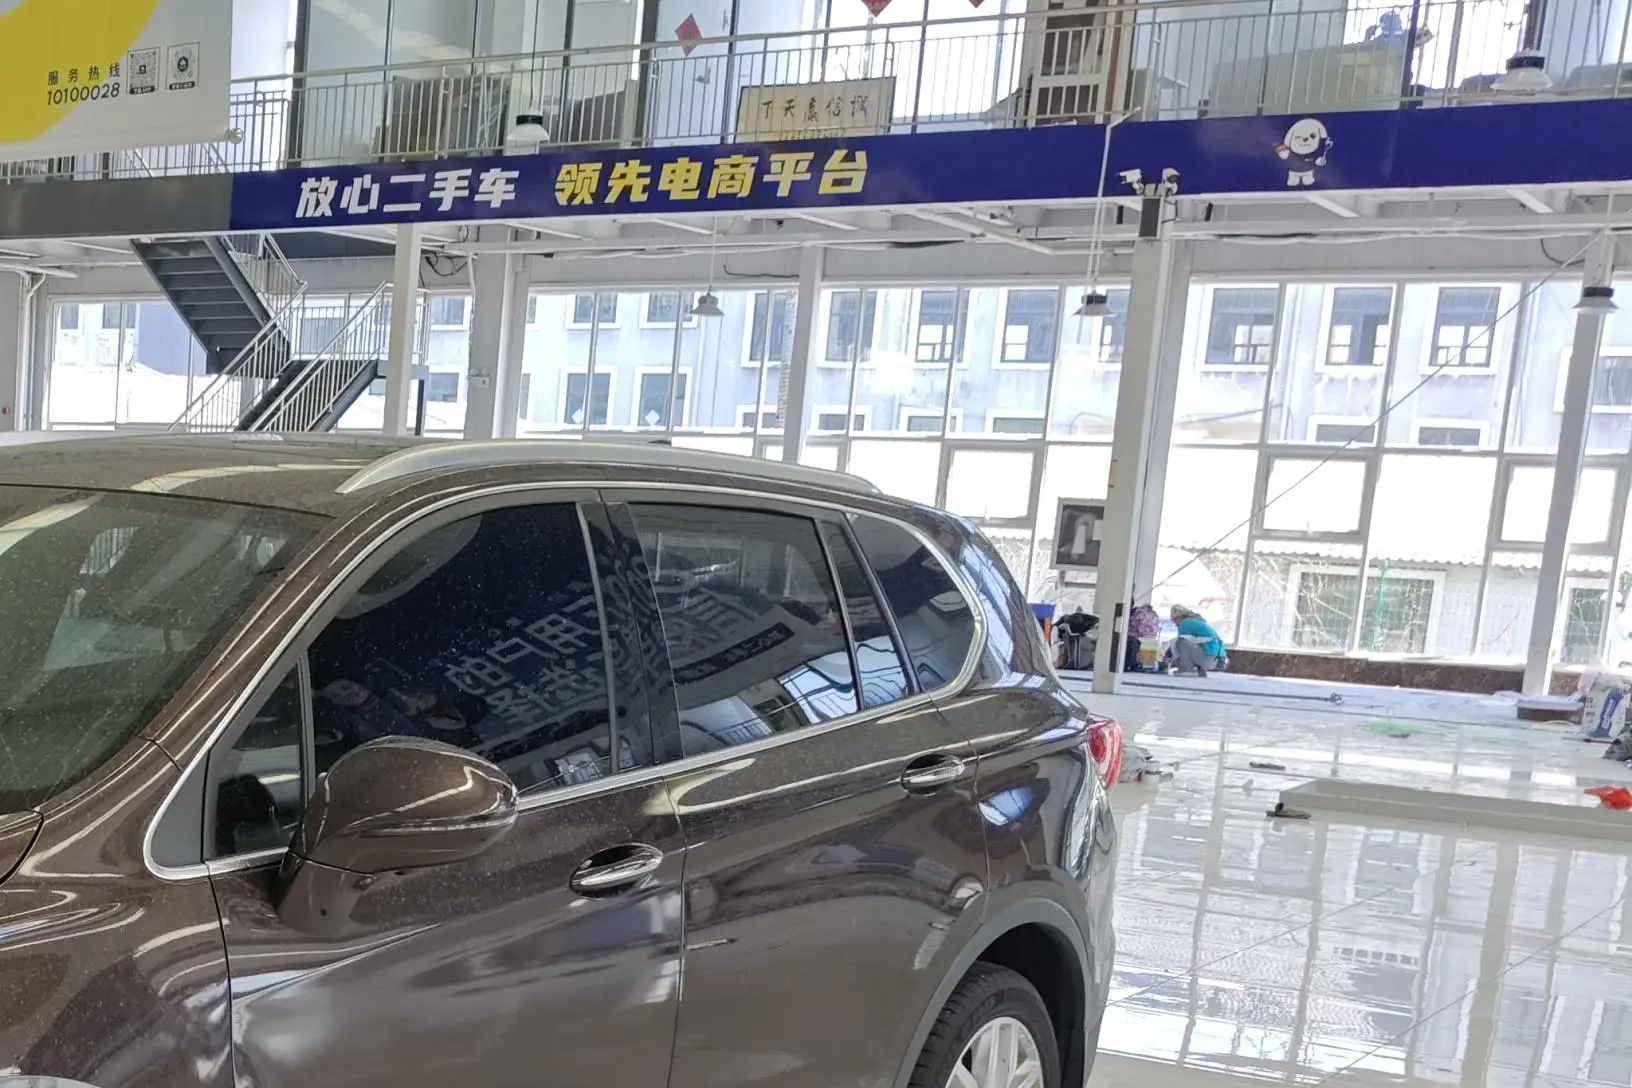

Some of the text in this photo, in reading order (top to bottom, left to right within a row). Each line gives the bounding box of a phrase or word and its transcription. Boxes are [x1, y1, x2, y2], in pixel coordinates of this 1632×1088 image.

[48, 62, 120, 86] 服务热线
[47, 82, 121, 106] 10100028
[294, 150, 869, 218] 放心二手车 领先电商平台
